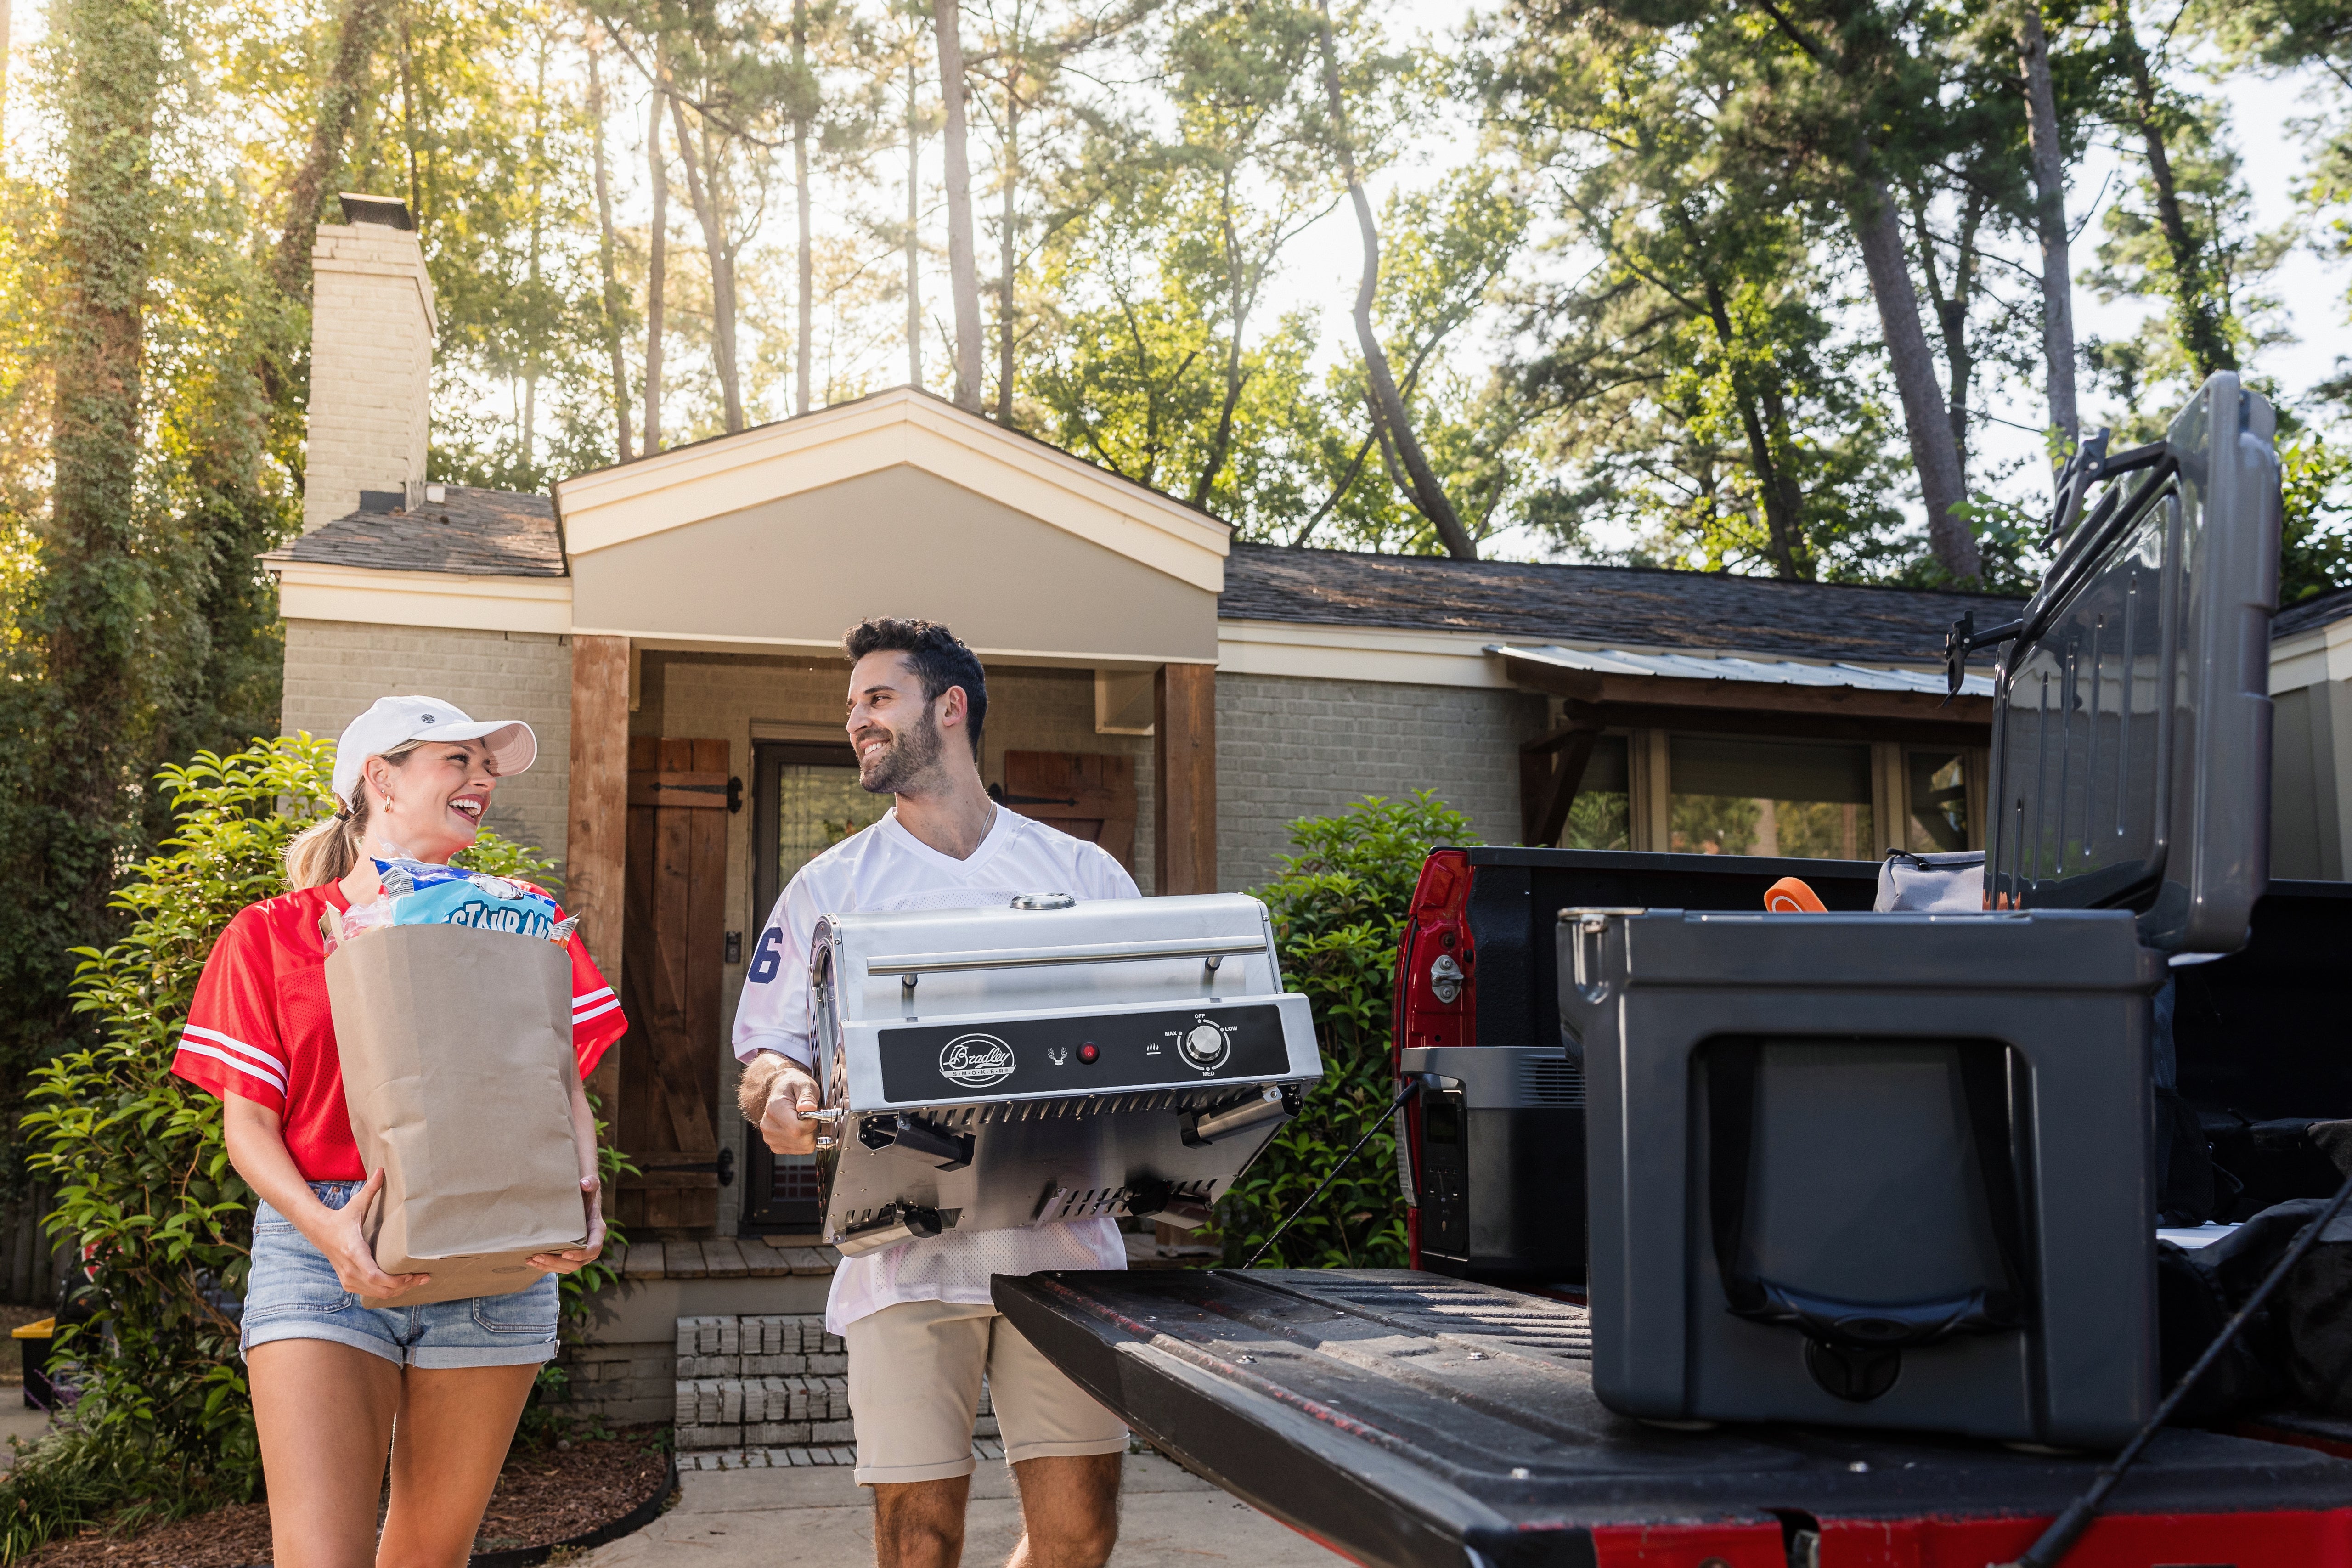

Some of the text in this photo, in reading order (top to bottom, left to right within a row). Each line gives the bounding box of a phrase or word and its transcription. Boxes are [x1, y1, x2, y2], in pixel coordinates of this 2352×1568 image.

[441, 903, 553, 942] STAURANT
[748, 927, 784, 984] 6
[943, 1044, 1010, 1069] Bradley
